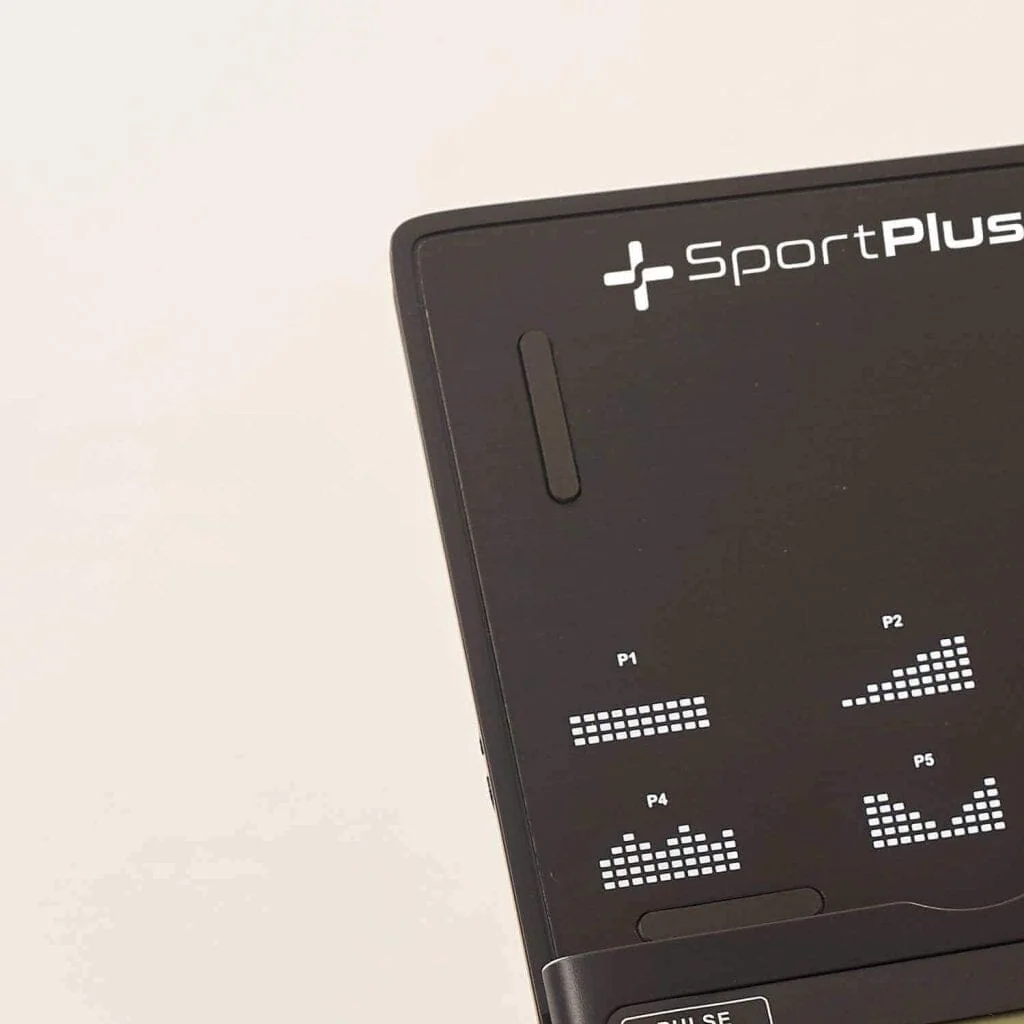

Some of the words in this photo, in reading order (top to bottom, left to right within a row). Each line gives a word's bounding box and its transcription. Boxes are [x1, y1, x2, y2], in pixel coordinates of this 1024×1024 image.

[686, 211, 1024, 287] SportPlus
[881, 614, 904, 629] P2
[616, 651, 637, 667] P1
[913, 752, 935, 769] P5
[646, 792, 669, 809] P4
